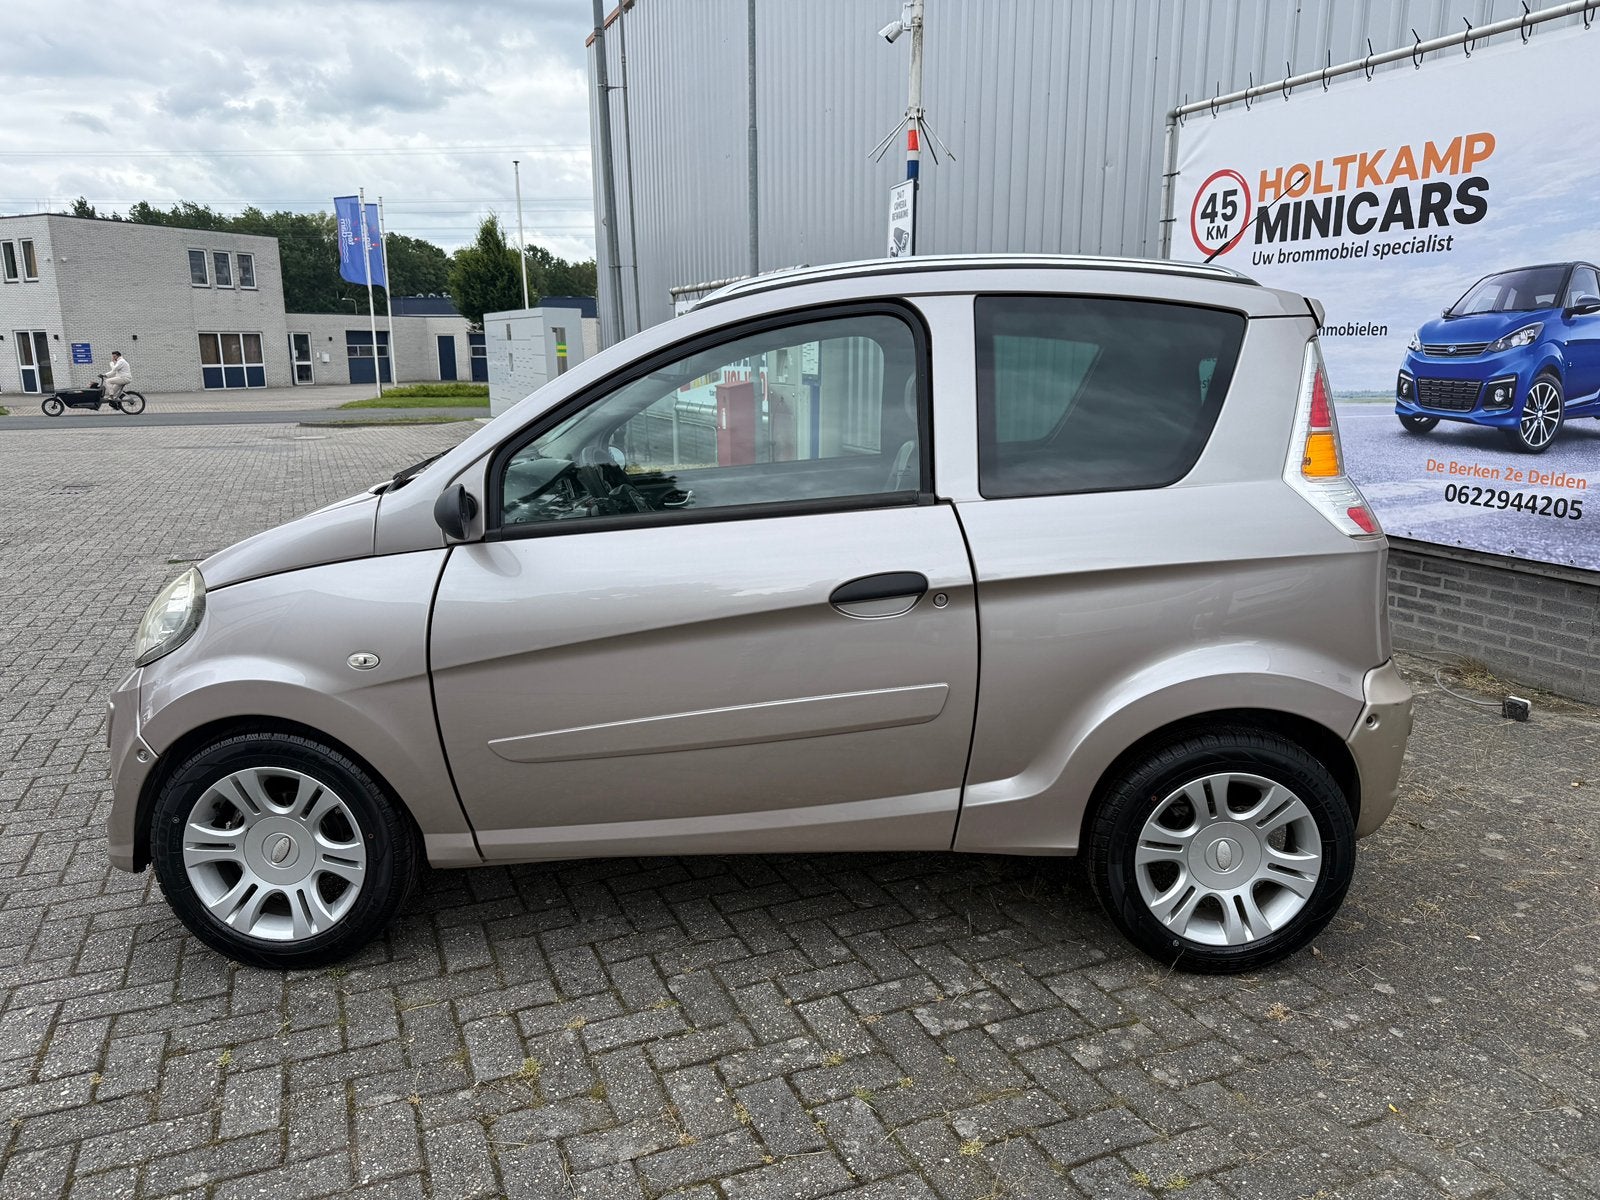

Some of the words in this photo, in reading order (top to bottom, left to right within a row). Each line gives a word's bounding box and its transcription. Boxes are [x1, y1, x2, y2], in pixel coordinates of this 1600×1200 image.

[1258, 132, 1496, 203] HOLTKAMP
[1200, 189, 1238, 224] 45
[1254, 176, 1490, 245] MINICARS
[1206, 224, 1228, 241] KM
[1252, 251, 1274, 266] Uw
[1277, 240, 1369, 264] brommobiel
[1372, 234, 1454, 261] specialist
[1426, 459, 1445, 473] De
[1449, 461, 1500, 480] Berken
[1504, 467, 1523, 482] 2e
[1528, 470, 1587, 490] Delden
[1444, 483, 1583, 520] 0622944205
